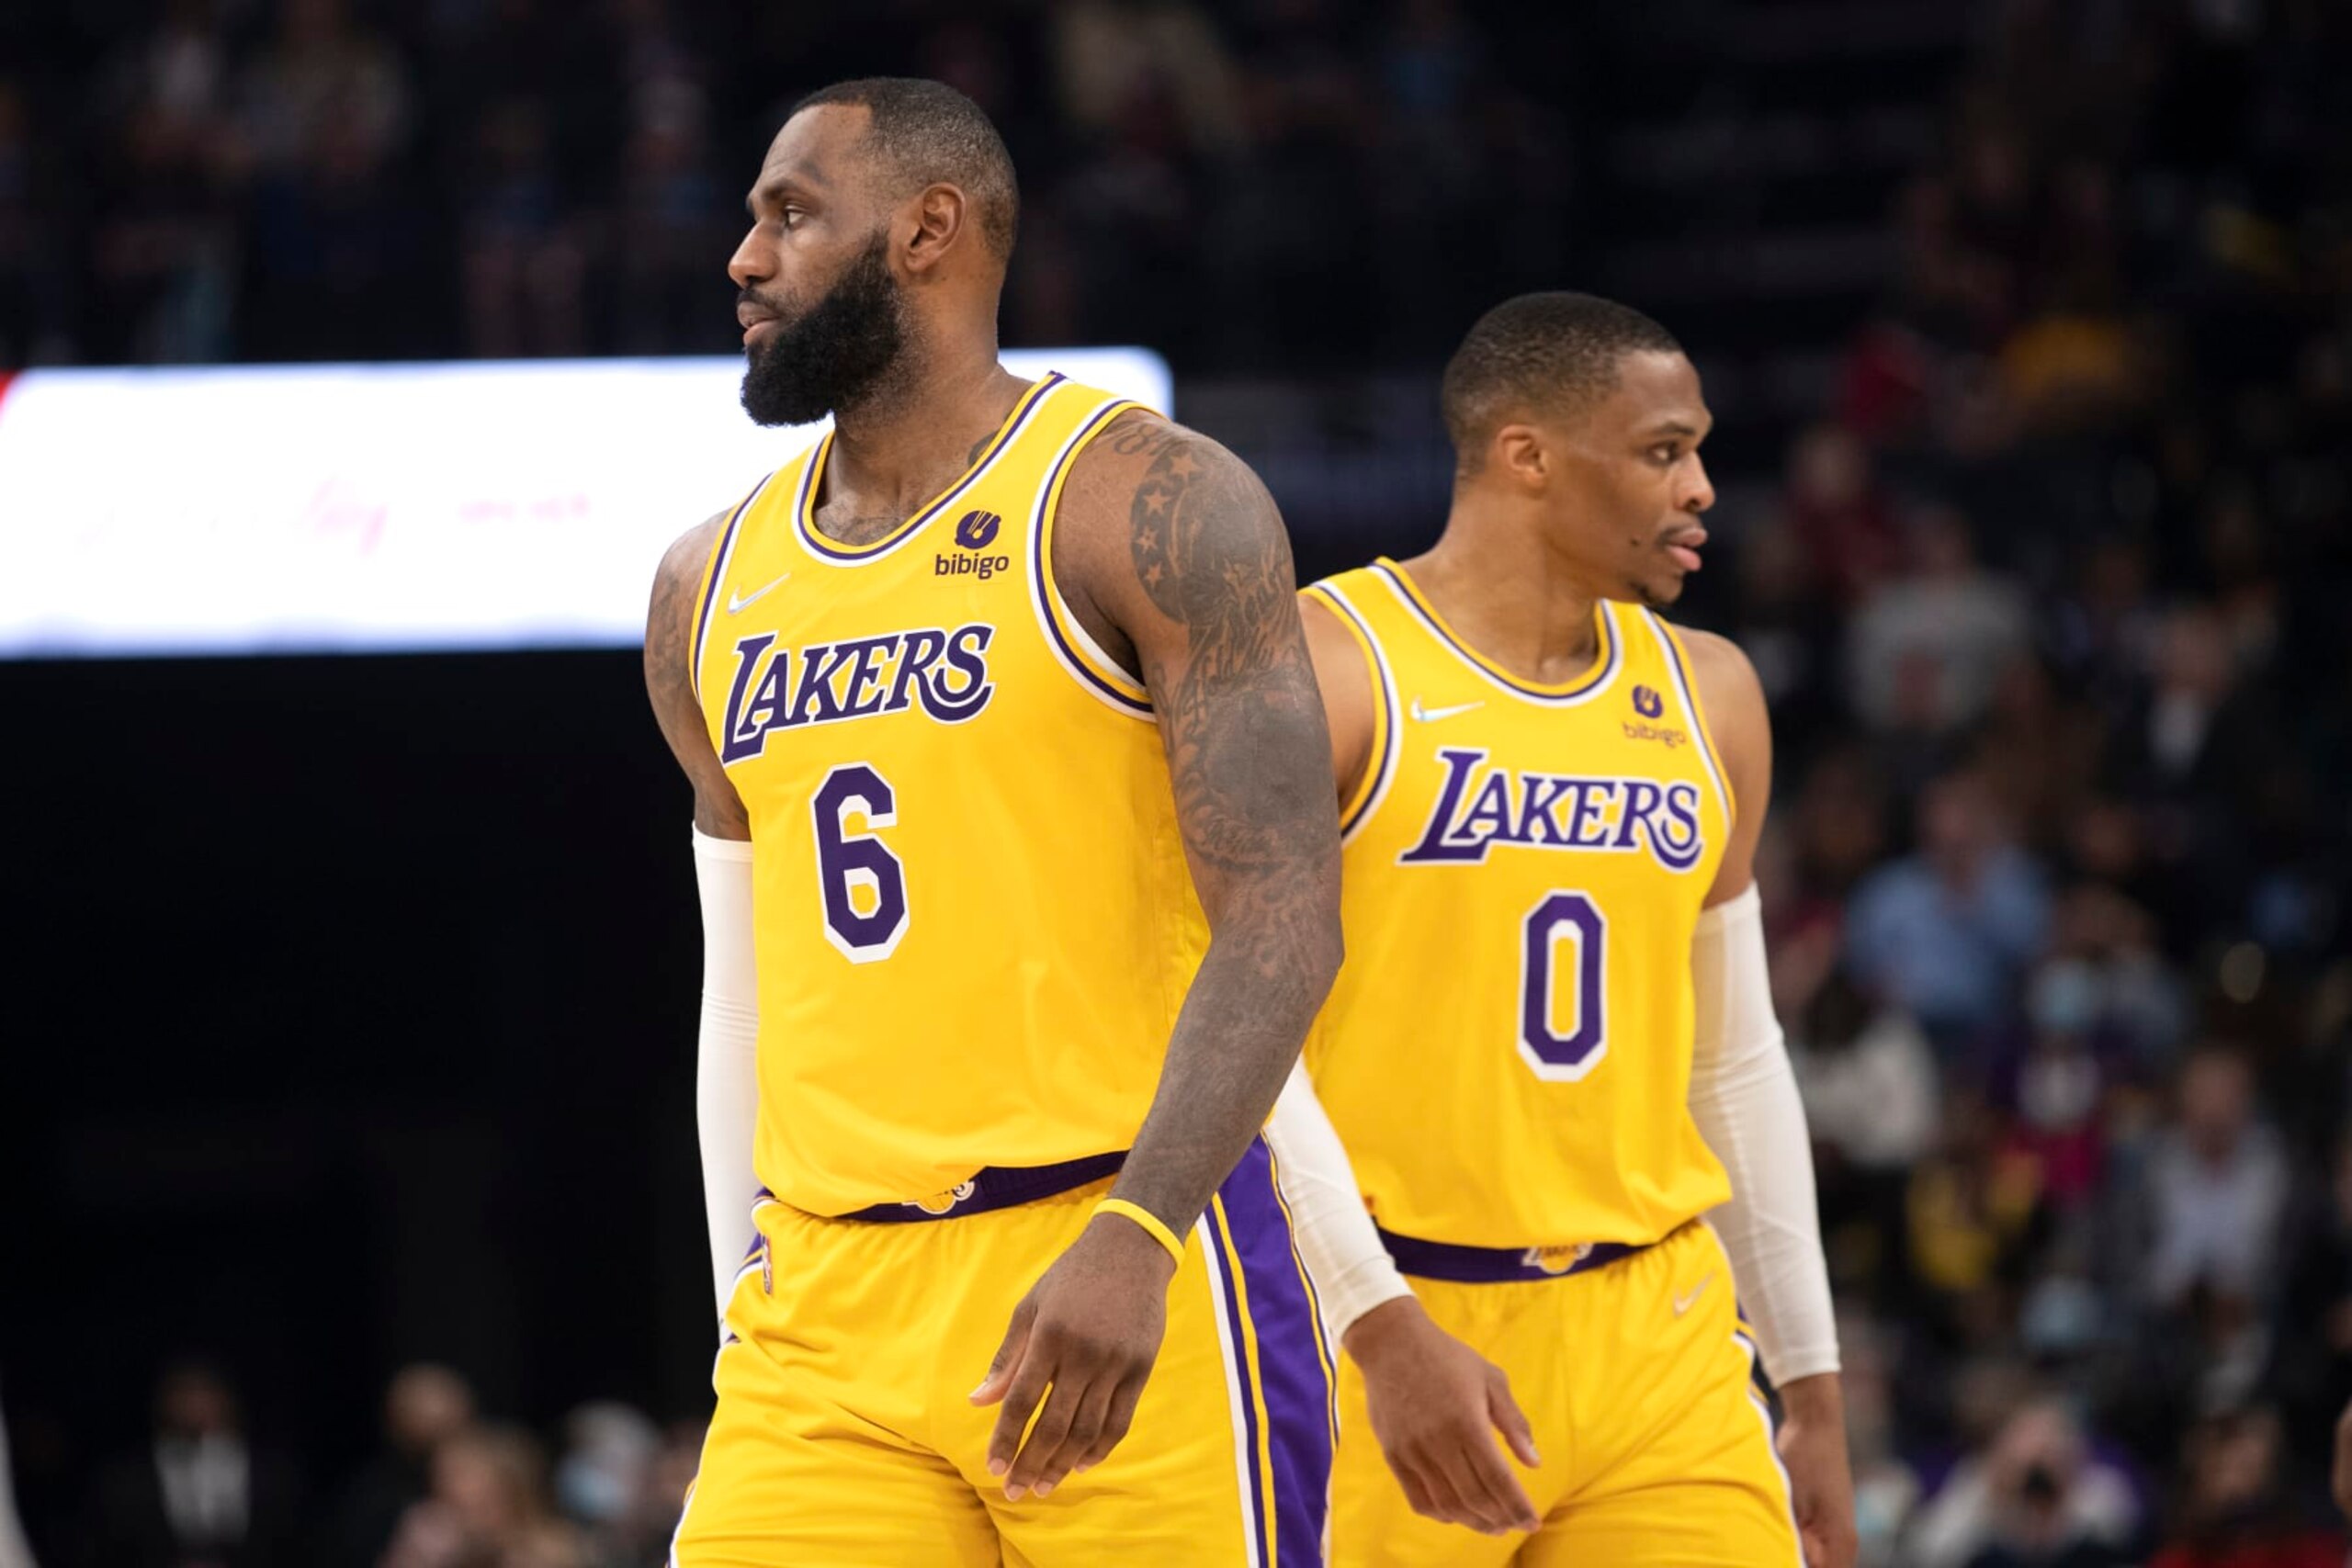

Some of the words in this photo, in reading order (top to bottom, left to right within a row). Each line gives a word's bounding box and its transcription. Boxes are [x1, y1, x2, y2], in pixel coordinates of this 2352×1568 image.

[935, 552, 1009, 580] bibigo
[720, 624, 996, 766] LAKERS
[810, 762, 909, 964] 6
[1396, 747, 1702, 873] LAKERS
[1518, 889, 1608, 1082] 0
